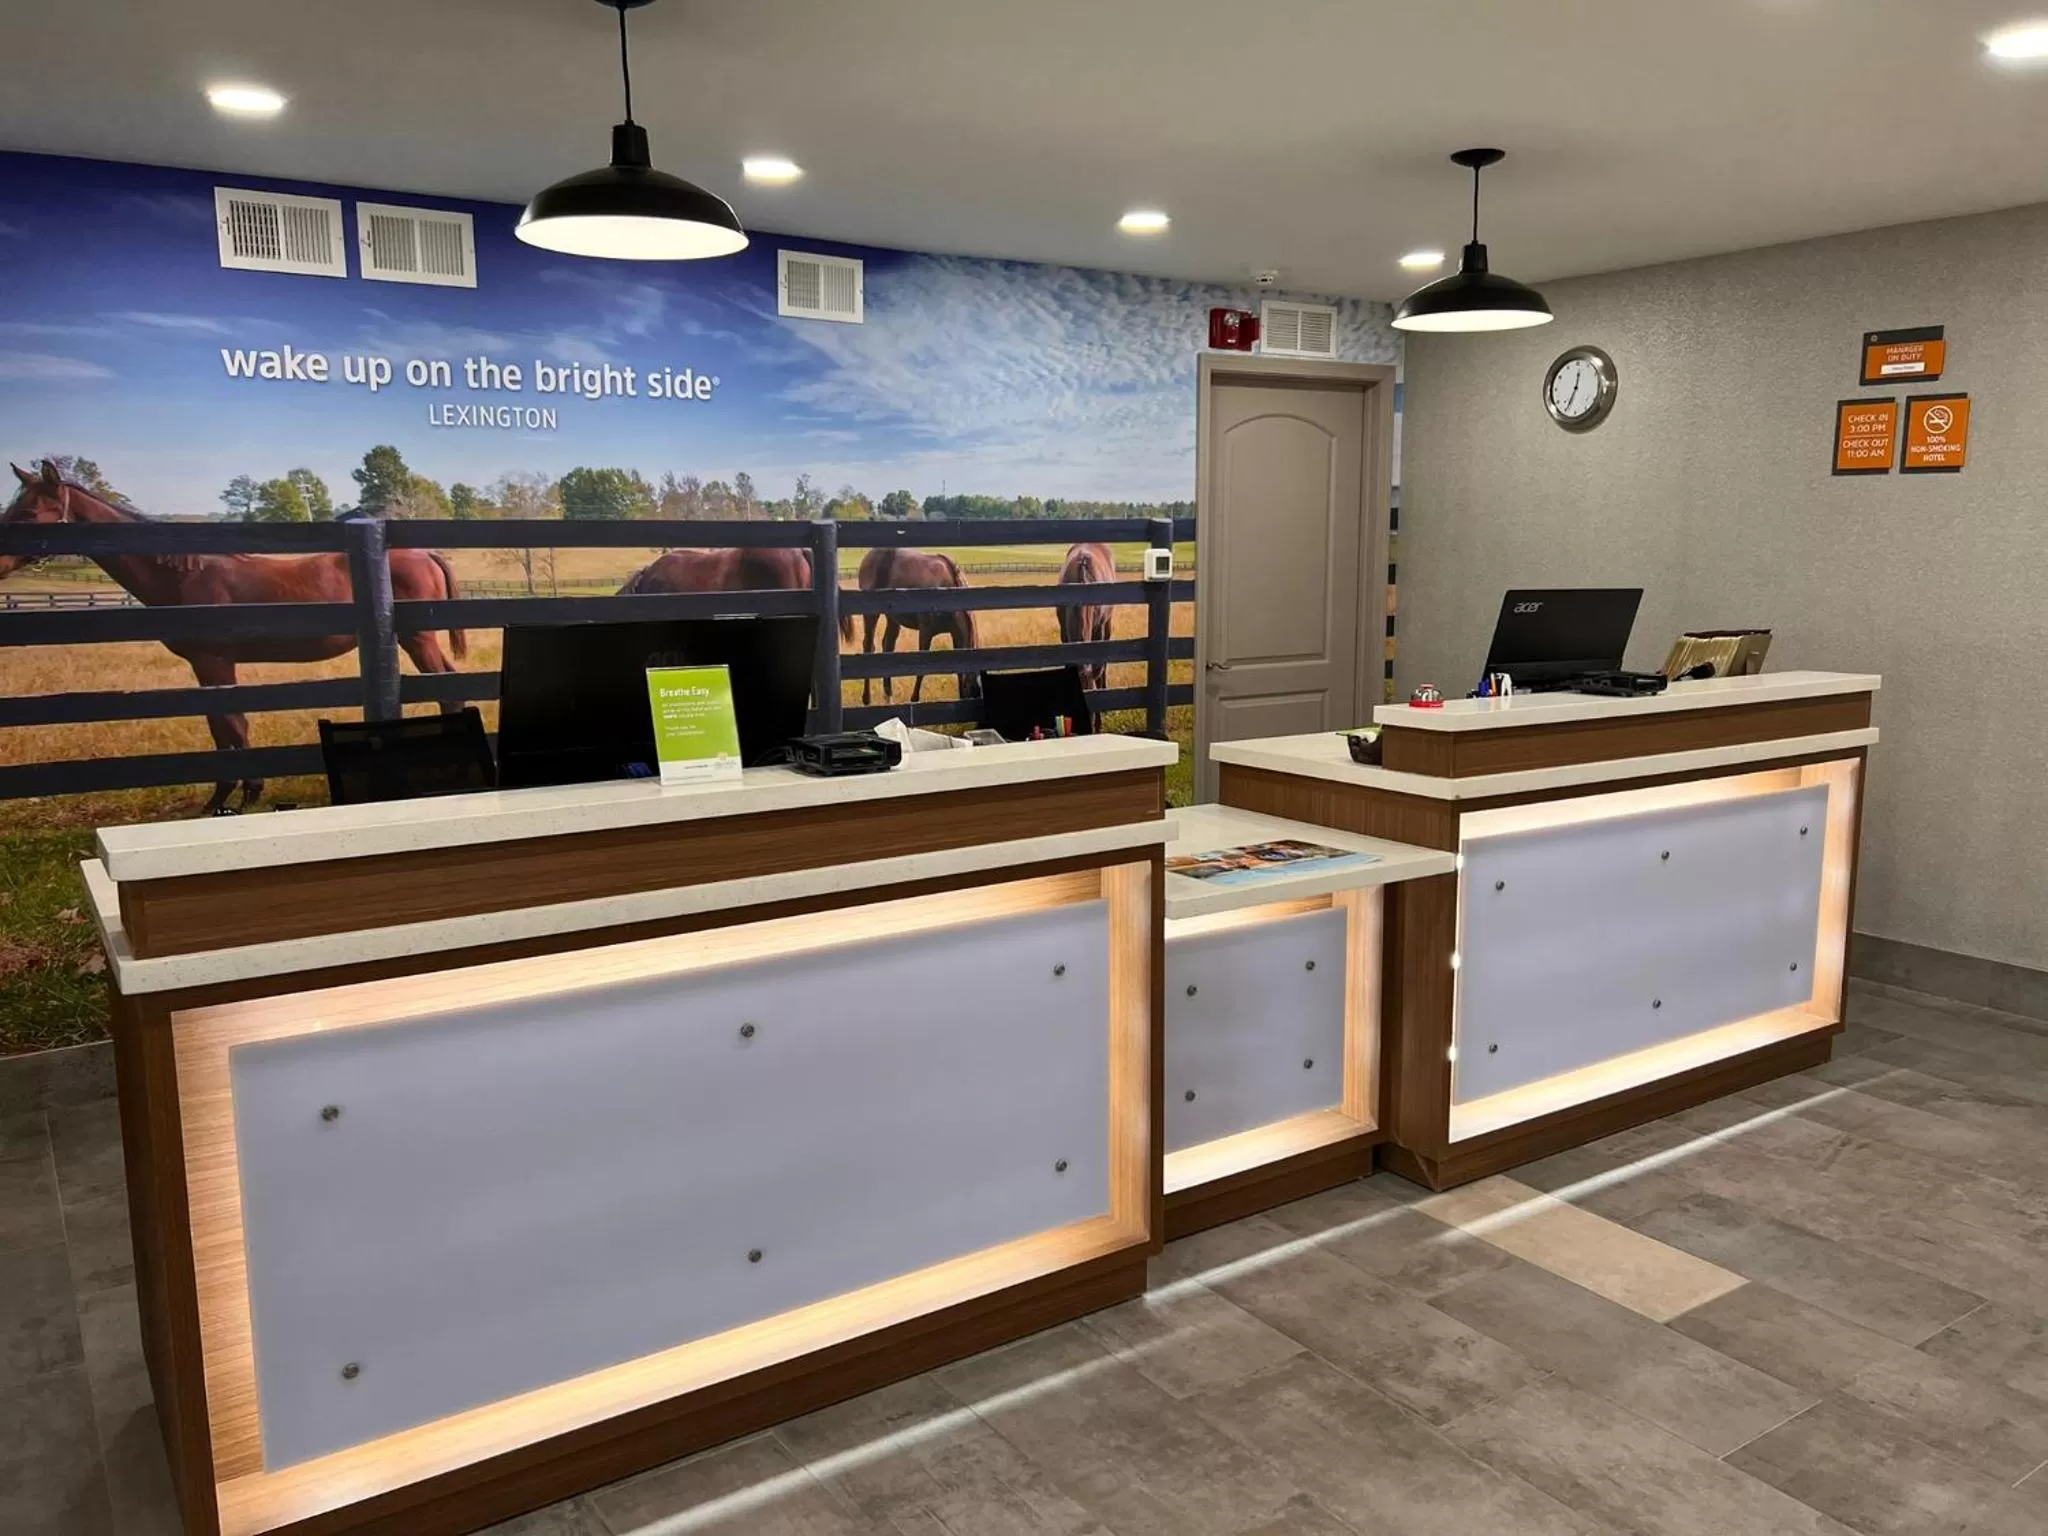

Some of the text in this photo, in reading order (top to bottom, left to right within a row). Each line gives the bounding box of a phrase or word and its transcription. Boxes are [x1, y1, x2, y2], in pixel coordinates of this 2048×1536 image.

[1886, 344, 1925, 354] MANAGER
[1901, 353, 1922, 361] DUTY
[221, 344, 329, 382] wake
[343, 355, 393, 392] up
[406, 357, 451, 387] on
[464, 356, 522, 390] the
[535, 360, 637, 399] bright
[429, 403, 557, 430] LEXINGTON
[1848, 412, 1889, 423] CHECK IN
[1872, 423, 1887, 432] PM
[1842, 438, 1889, 449] CHECK OUT
[1847, 448, 1885, 458] 11:00 AM
[1923, 453, 1946, 462] HOTEL
[1514, 602, 1544, 613] acer
[659, 686, 710, 698] Breathe Easy
